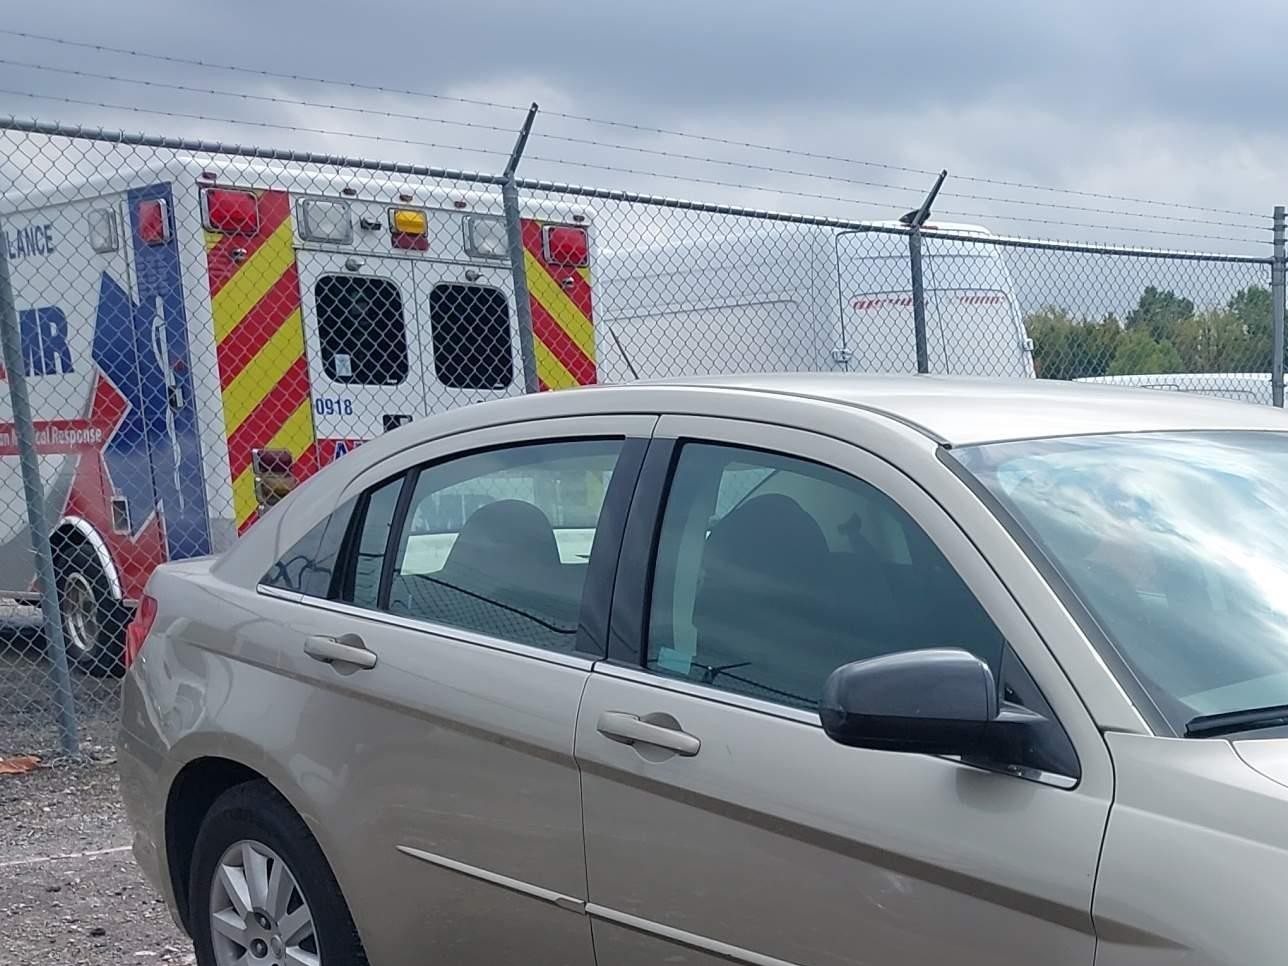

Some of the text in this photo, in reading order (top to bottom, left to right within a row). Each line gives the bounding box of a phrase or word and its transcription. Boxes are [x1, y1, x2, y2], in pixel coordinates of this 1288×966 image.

[0, 305, 75, 378] MR
[315, 398, 353, 416] 0918
[51, 425, 102, 449] Response
